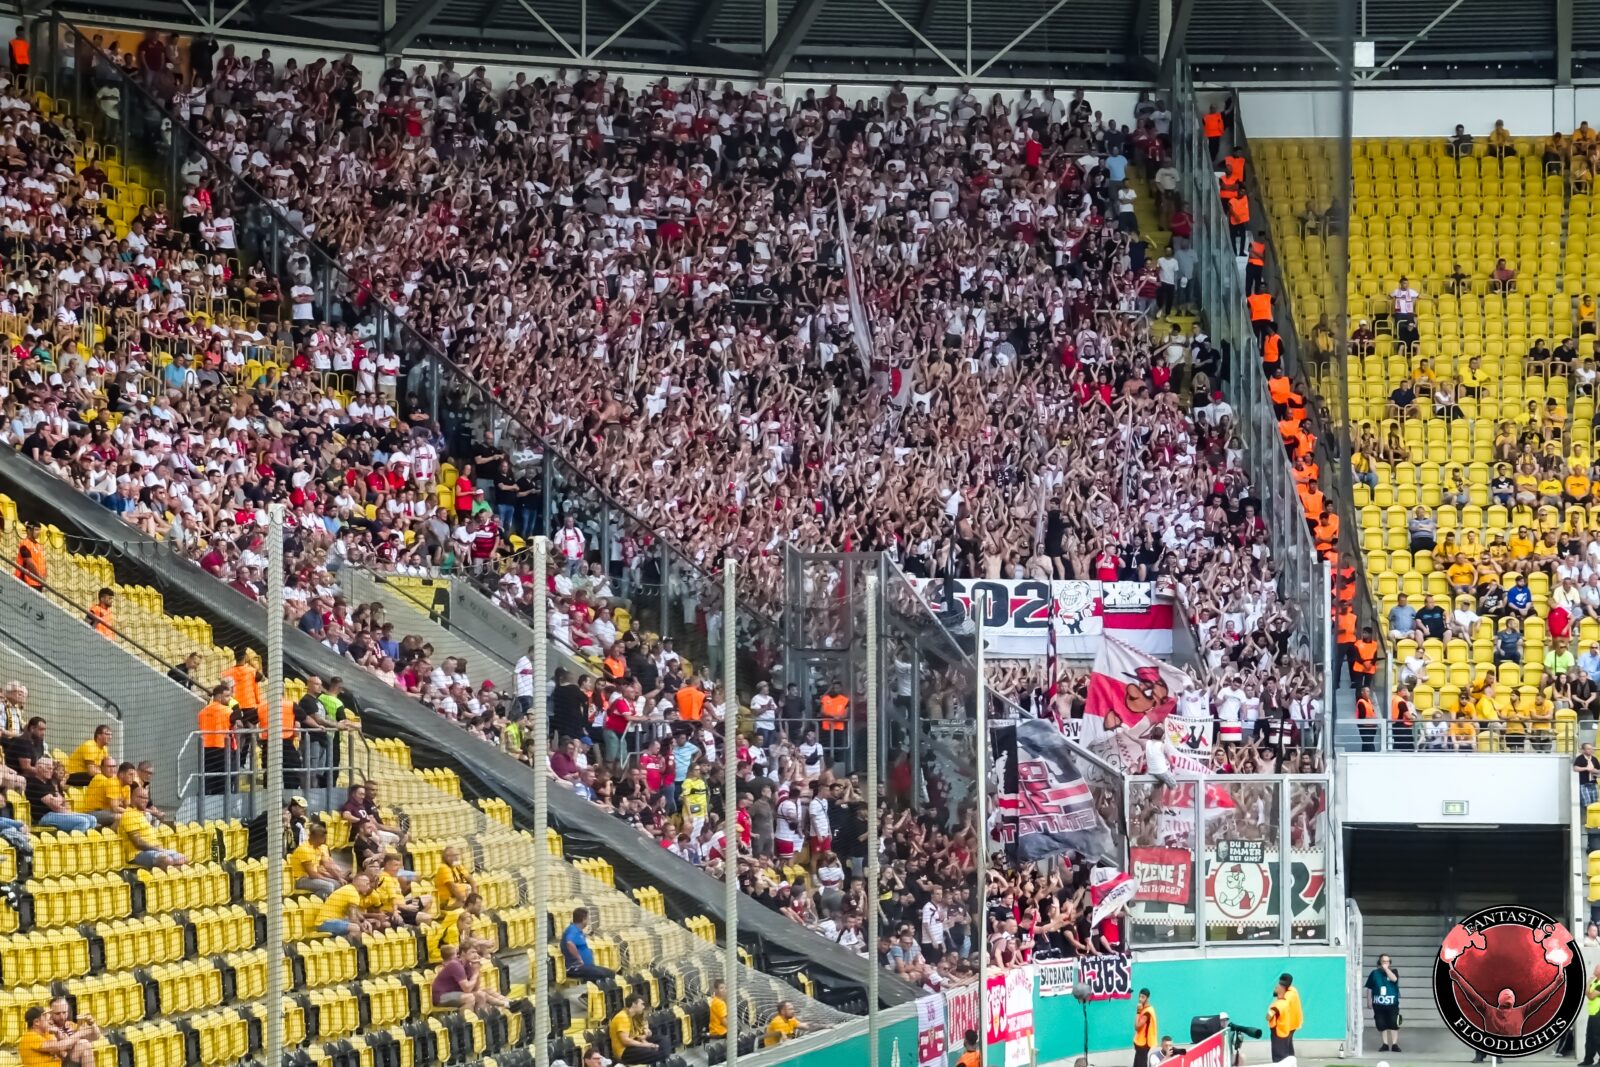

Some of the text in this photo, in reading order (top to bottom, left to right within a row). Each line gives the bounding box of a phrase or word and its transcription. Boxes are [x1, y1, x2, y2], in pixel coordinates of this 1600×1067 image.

[1229, 841, 1242, 849] DU
[1229, 848, 1262, 856] IMMER
[1134, 860, 1187, 888] SZENE E
[1373, 995, 1395, 1004] HOST
[948, 991, 980, 1044] URBAC
